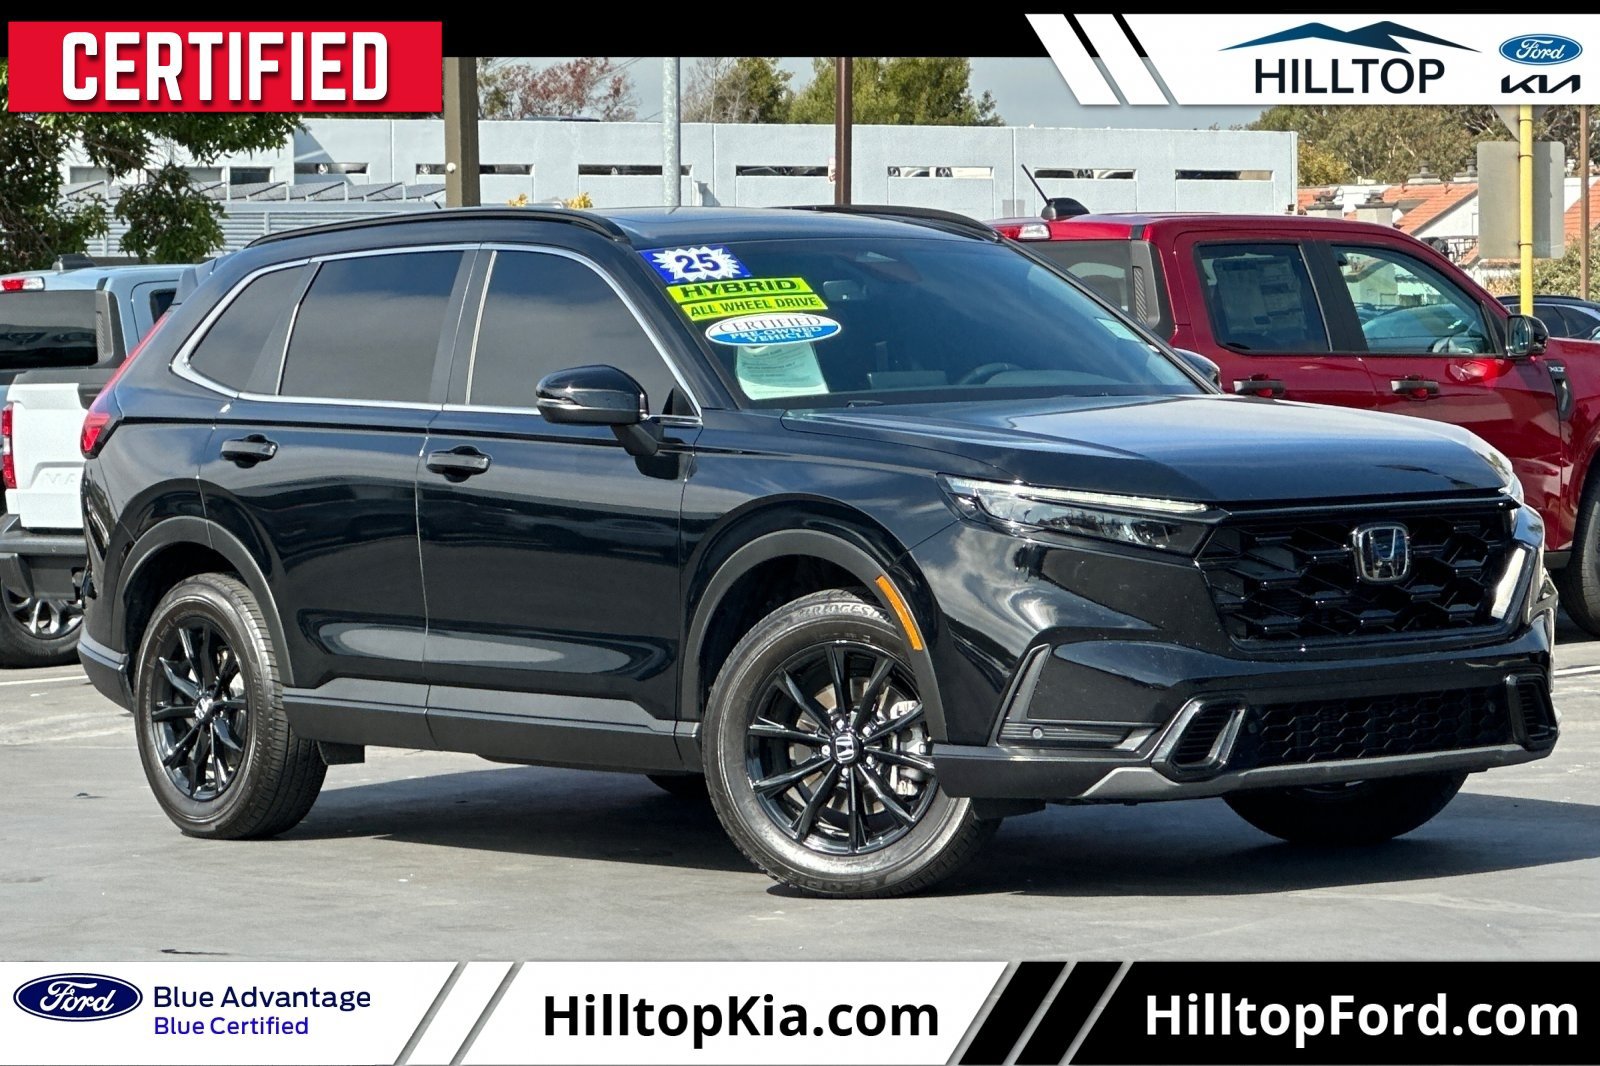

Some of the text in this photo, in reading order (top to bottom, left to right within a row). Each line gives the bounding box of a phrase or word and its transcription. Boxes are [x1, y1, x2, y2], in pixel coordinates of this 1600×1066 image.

[674, 252, 721, 274] 25
[680, 280, 797, 298] HYBRID
[690, 296, 819, 317] ALL WHEEL DRIVE
[719, 316, 821, 333] CERTIFIED
[730, 326, 823, 340] PRE-OWNED
[746, 332, 815, 343] VEHICLE
